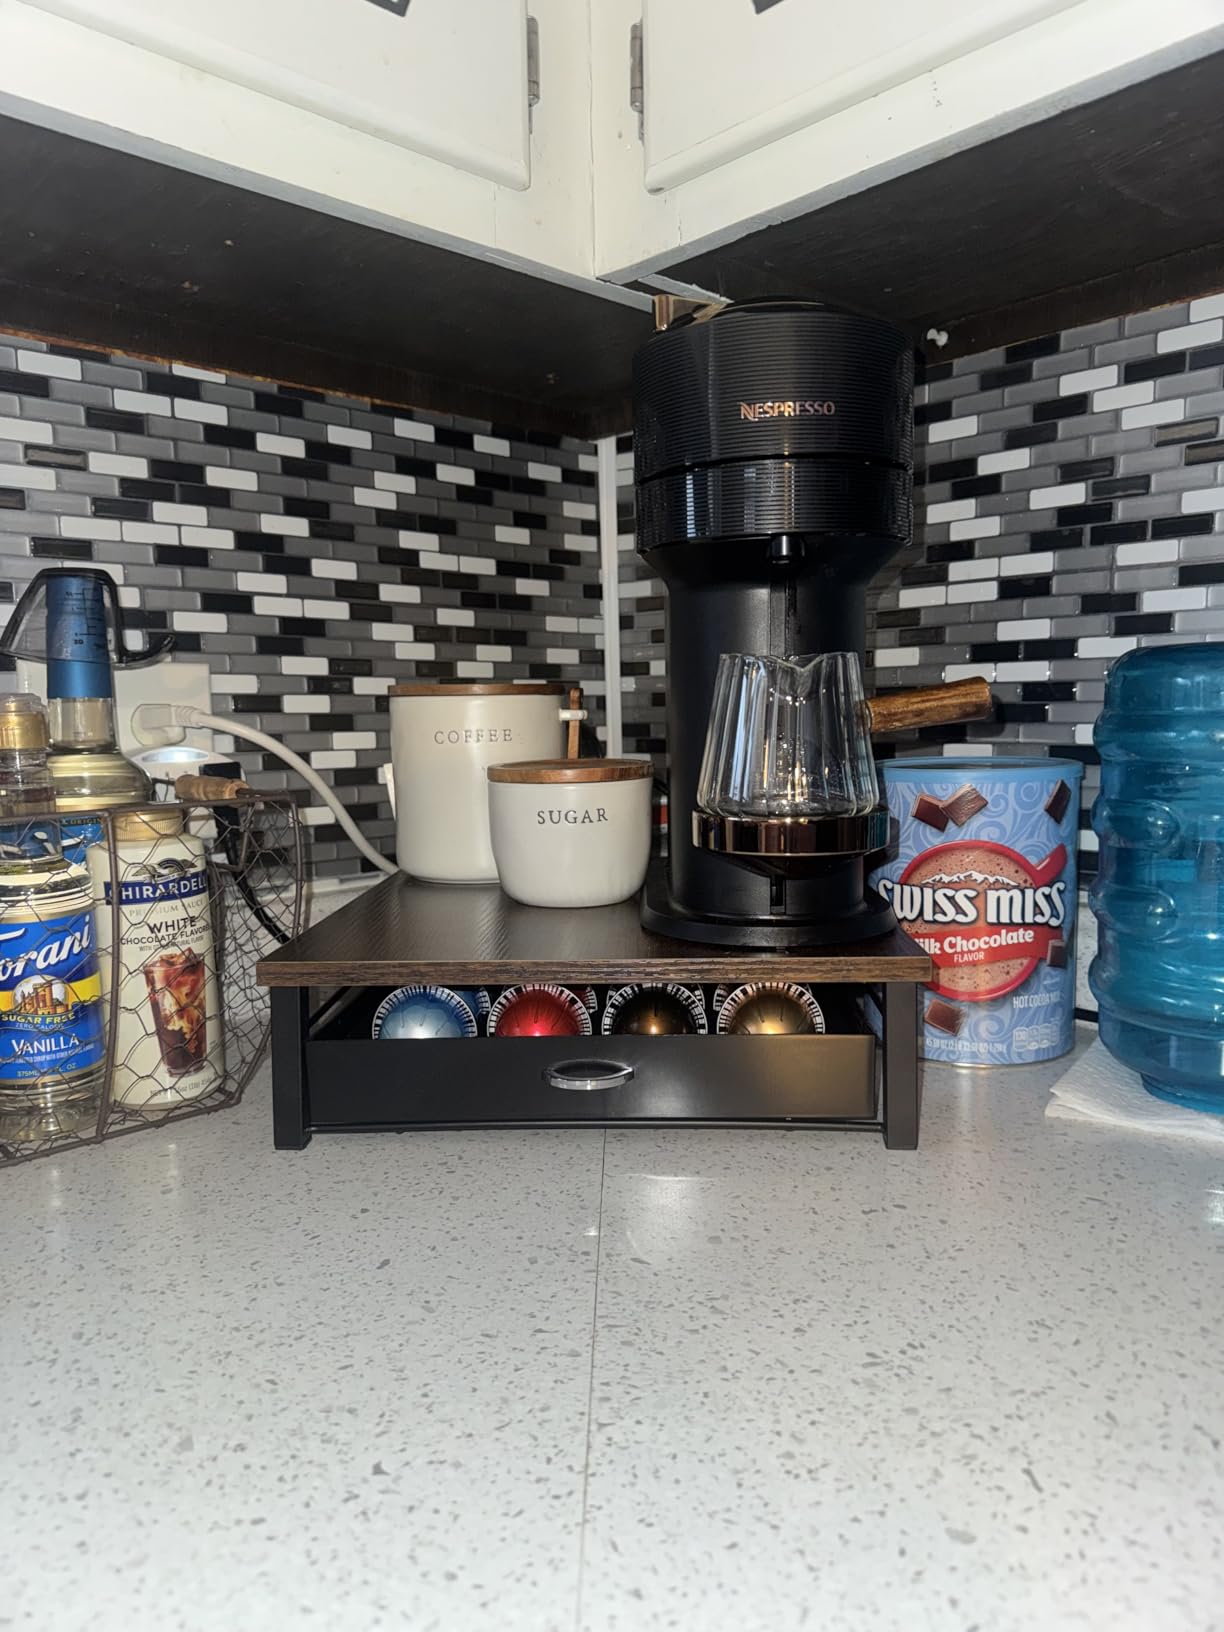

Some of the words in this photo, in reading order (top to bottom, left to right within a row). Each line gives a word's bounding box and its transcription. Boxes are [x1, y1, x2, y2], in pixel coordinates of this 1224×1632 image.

[737, 401, 835, 421] NESPRESSO
[434, 728, 513, 744] COFFEE
[537, 807, 608, 825] SUGAR
[145, 916, 197, 934] WHITE
[120, 932, 179, 945] CHOCOLATE
[913, 937, 942, 955] ilk
[943, 928, 1034, 953] Chocolate
[954, 951, 985, 963] FLAVOR
[1, 1014, 41, 1024] SUGAR
[11, 1034, 80, 1055] VANILLA
